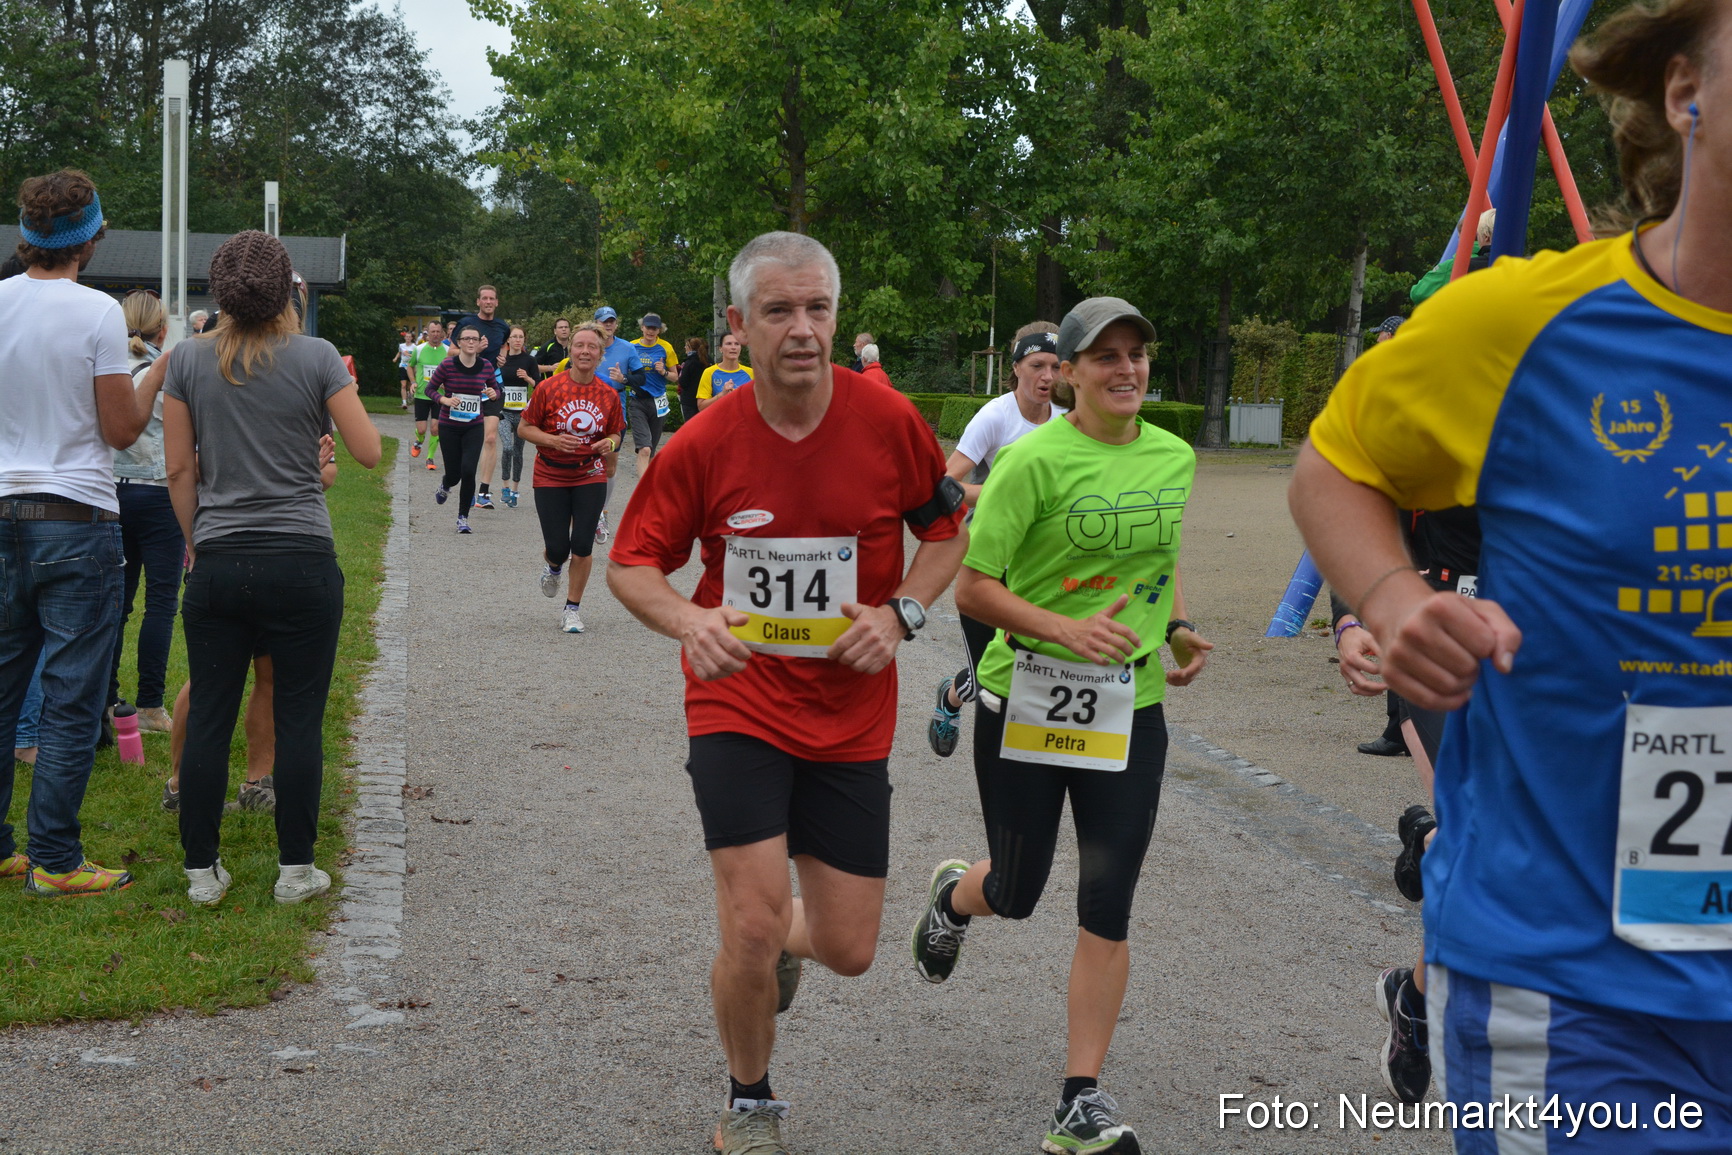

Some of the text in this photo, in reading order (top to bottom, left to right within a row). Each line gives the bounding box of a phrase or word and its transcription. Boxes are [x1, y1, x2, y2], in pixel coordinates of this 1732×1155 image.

[507, 392, 522, 401] 108
[557, 399, 604, 422] FINISHER
[1619, 399, 1642, 414] 15
[556, 421, 566, 430] 20
[1608, 419, 1656, 434] Jahre
[727, 543, 832, 562] PARTL Neumarkt
[748, 566, 830, 612] 314
[763, 622, 811, 641] Claus
[1016, 661, 1115, 684] PARTL Neumarkt
[1046, 685, 1098, 725] 23
[1044, 733, 1086, 752] Petra
[1631, 732, 1725, 755] PARTL
[1629, 850, 1638, 865] B
